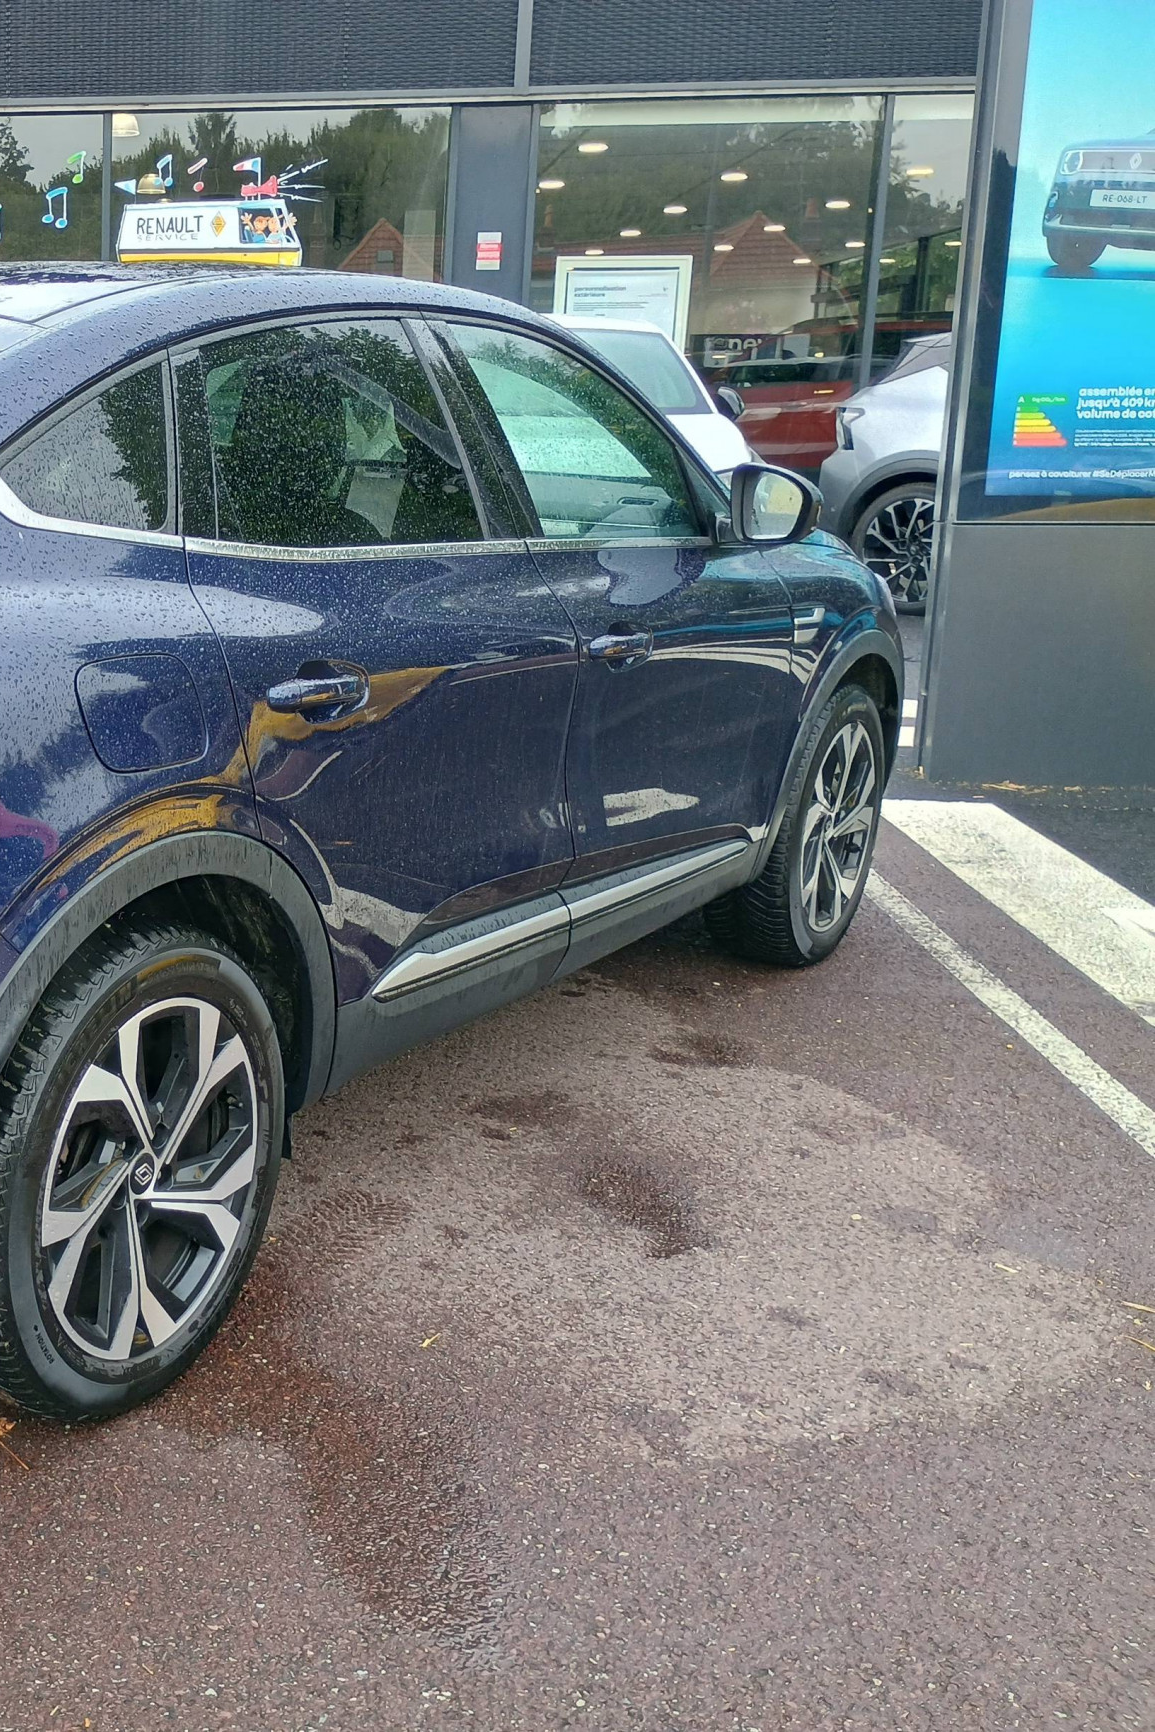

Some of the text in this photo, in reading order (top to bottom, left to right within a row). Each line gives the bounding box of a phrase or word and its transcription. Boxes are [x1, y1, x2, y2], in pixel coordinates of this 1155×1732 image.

[136, 215, 204, 234] RENAULT
[136, 233, 199, 242] SERVICE
[1079, 386, 1143, 397] assemblée
[1076, 397, 1121, 410] jusqu'à
[1121, 397, 1144, 407] 409
[1076, 408, 1121, 419] volume
[1121, 408, 1137, 419] de
[1008, 470, 1040, 479] pensez
[1041, 470, 1048, 478] à
[1048, 470, 1092, 478] covoiturer
[34, 1332, 56, 1365] ROTATION
